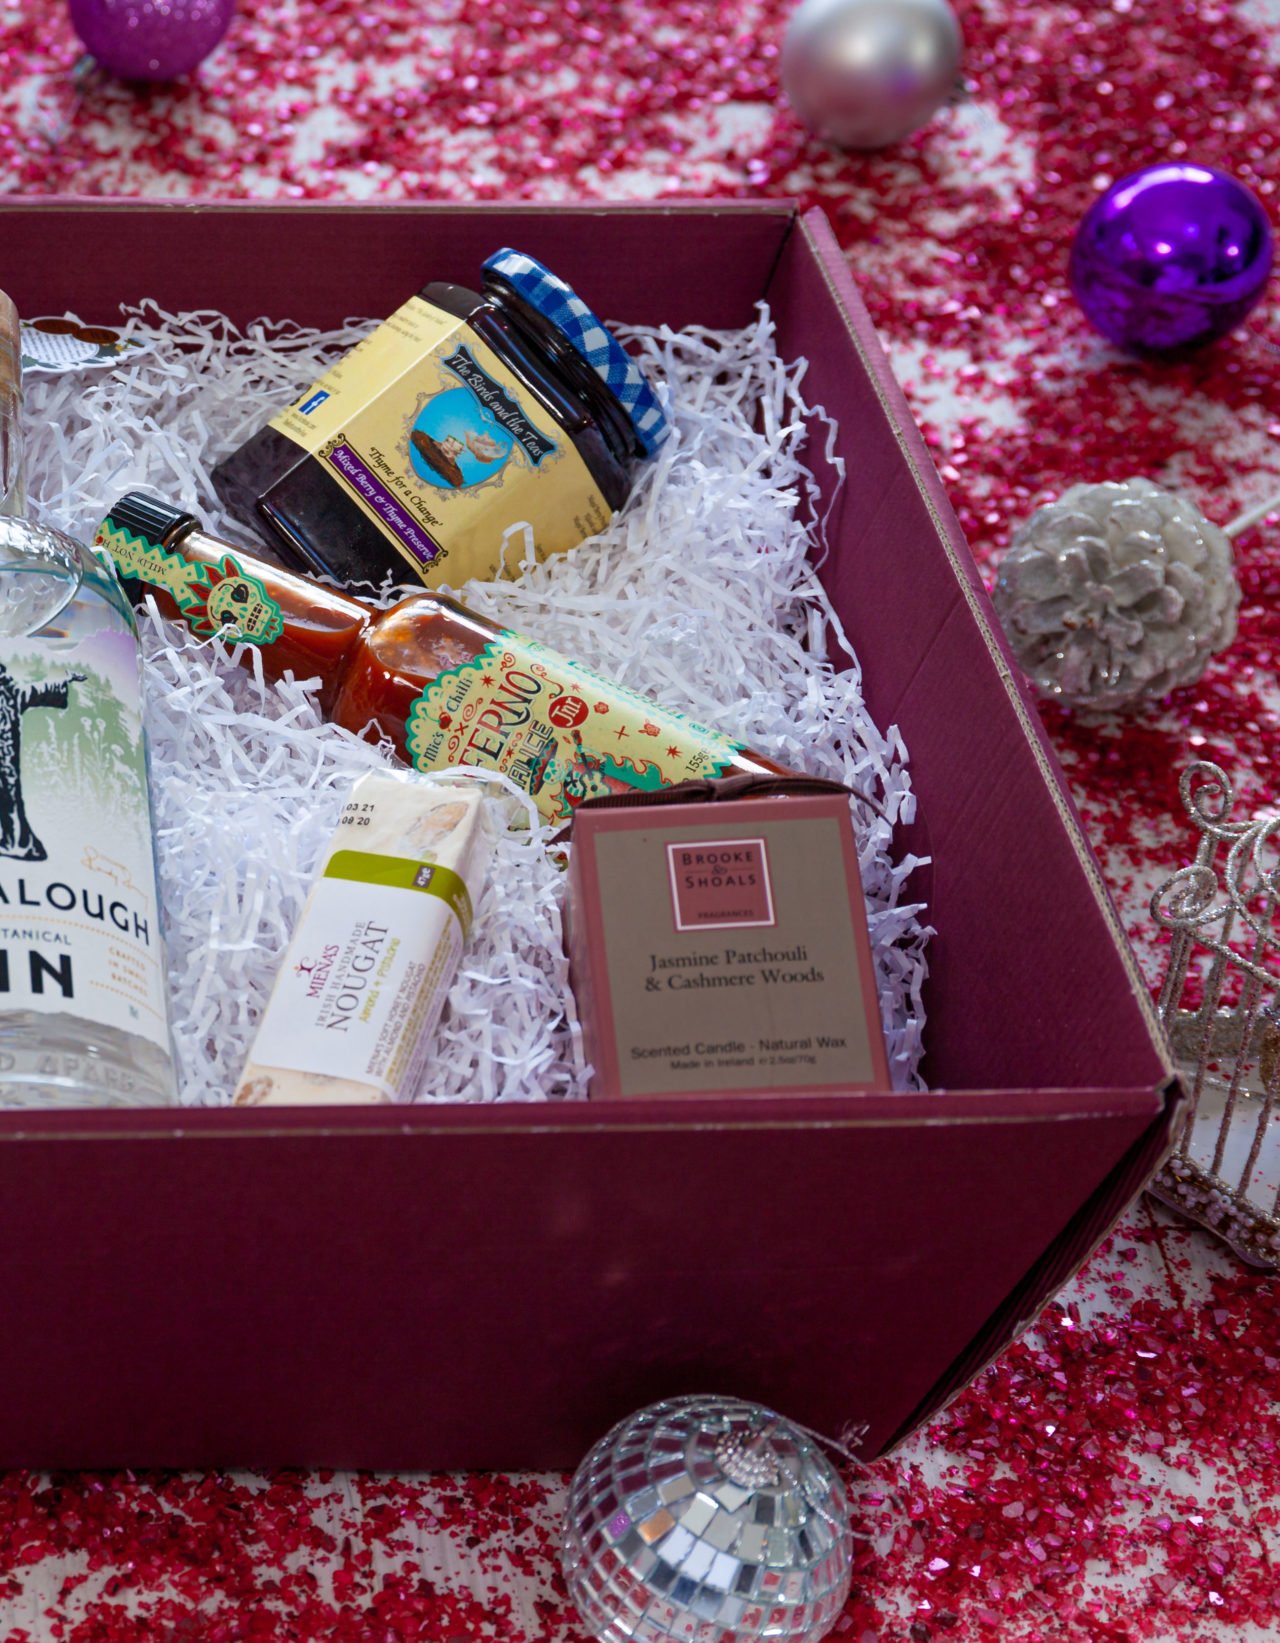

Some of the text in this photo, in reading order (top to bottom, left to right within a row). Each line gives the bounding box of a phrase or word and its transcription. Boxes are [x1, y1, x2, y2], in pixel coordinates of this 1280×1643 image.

[451, 354, 544, 457] The Birds and the Teas
[387, 475, 408, 490] for
[403, 489, 413, 497] a
[334, 449, 361, 476] Mixed
[355, 472, 377, 497] Berry
[382, 503, 408, 530] Thyme
[403, 527, 434, 560] Preserve
[112, 546, 135, 561] NOT
[446, 677, 473, 713] Chilli
[423, 731, 445, 762] Mic's
[346, 803, 375, 812] 03 21
[357, 817, 371, 826] 20
[682, 851, 753, 866] BROOKE
[685, 873, 756, 889] SHOALS
[650, 945, 809, 972] Jasmine Patchouli
[315, 921, 366, 1027] IRISH HANDMADE
[326, 920, 389, 1033] NOUGAT
[644, 967, 825, 992] & Cashmere Woods
[631, 1036, 848, 1060] Scented Candle Natural Wax
[671, 1058, 701, 1070] Made
[717, 1056, 755, 1068] Ireland
